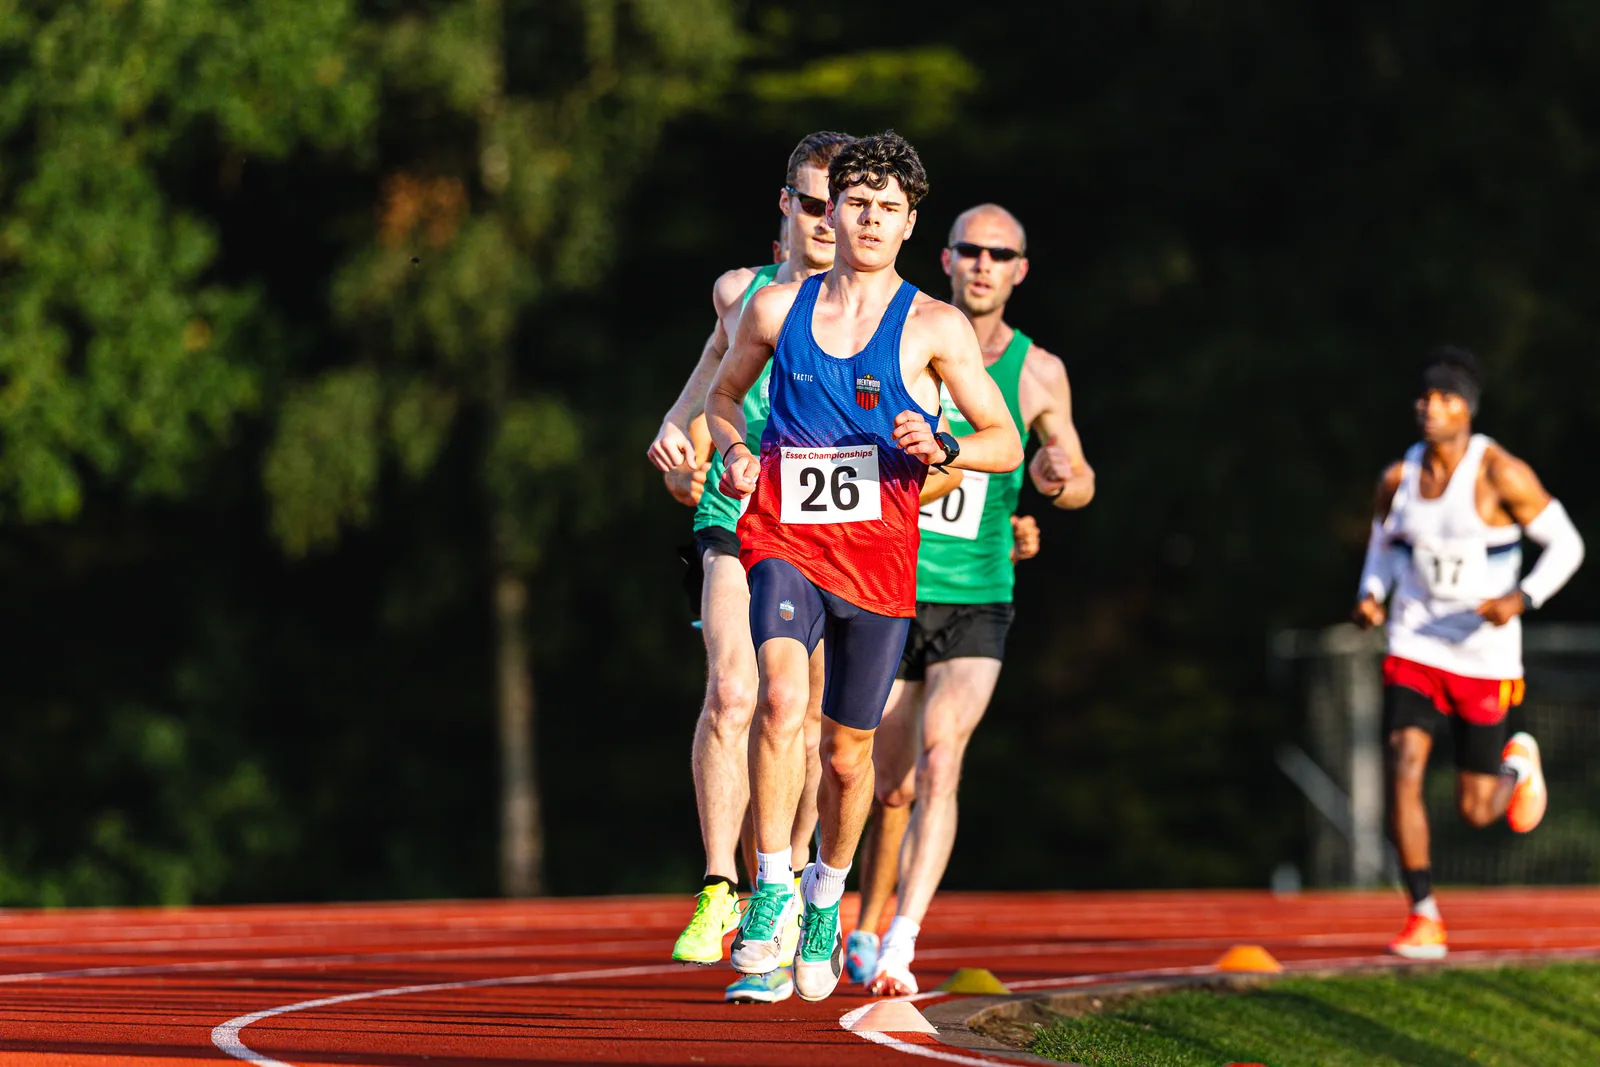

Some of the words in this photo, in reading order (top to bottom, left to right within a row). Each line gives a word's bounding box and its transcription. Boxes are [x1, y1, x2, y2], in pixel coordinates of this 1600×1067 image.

[793, 372, 813, 382] TACTIC
[785, 451, 807, 459] Essex
[808, 449, 873, 461] Championships
[799, 466, 860, 512] 26
[919, 486, 965, 522] 0
[1432, 555, 1463, 585] 17
